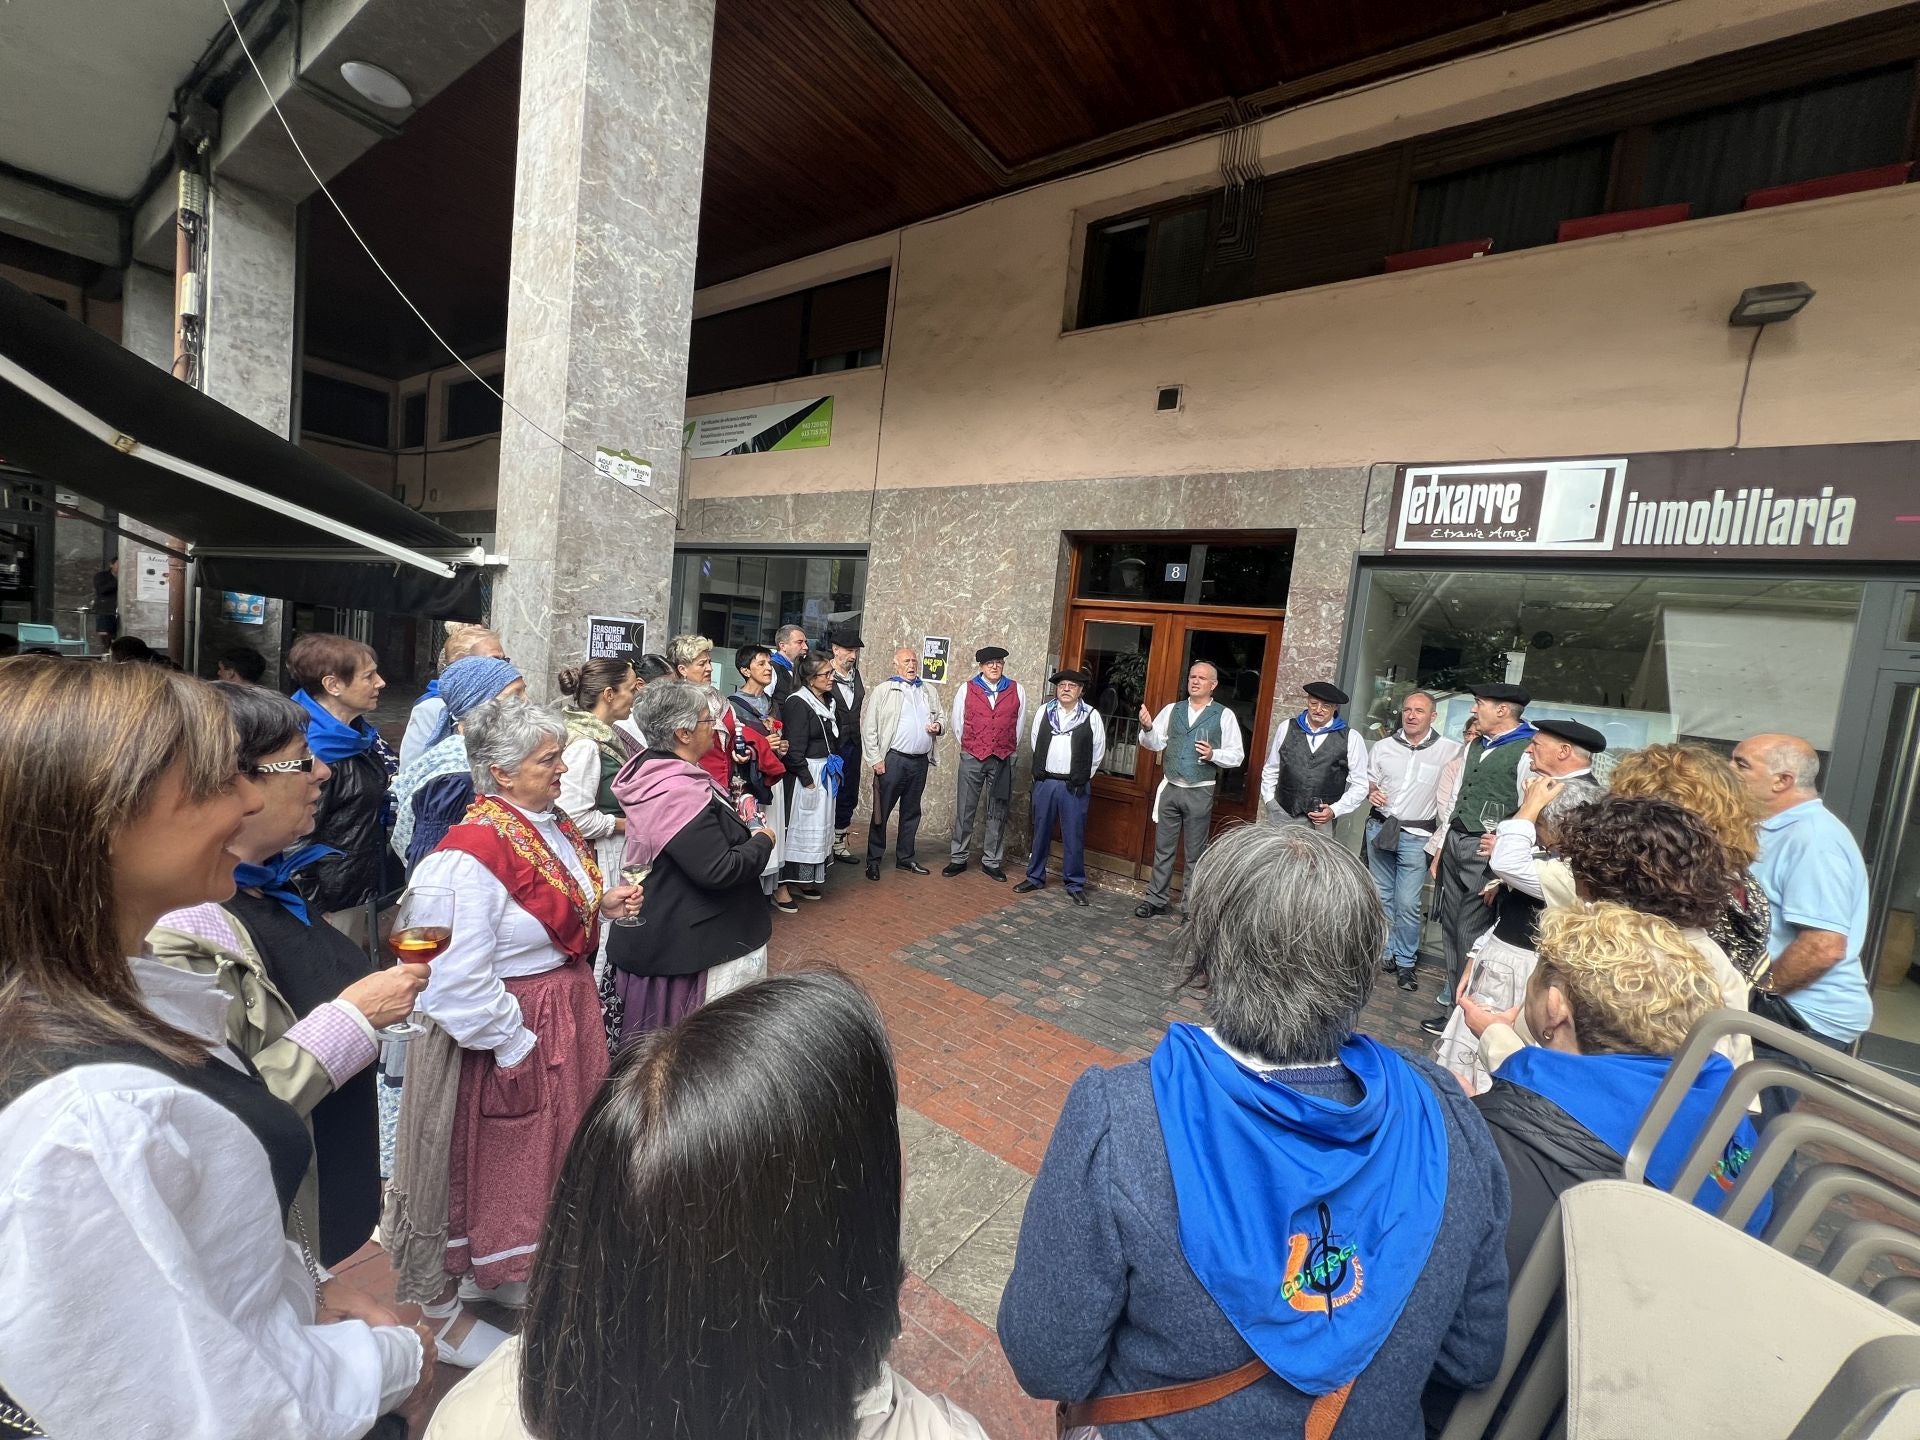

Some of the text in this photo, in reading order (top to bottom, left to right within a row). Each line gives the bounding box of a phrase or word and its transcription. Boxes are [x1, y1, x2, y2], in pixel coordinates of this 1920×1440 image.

[631, 467, 649, 477] HEMEN
[1407, 474, 1522, 525] etxarre
[1621, 486, 1857, 546] inmobiliaria
[1488, 526, 1532, 542] Arregi
[1171, 566, 1180, 579] 8
[592, 624, 626, 636] ERASOREN
[592, 632, 622, 643] BAT IKUSI
[591, 640, 633, 652] EDO JASATEN
